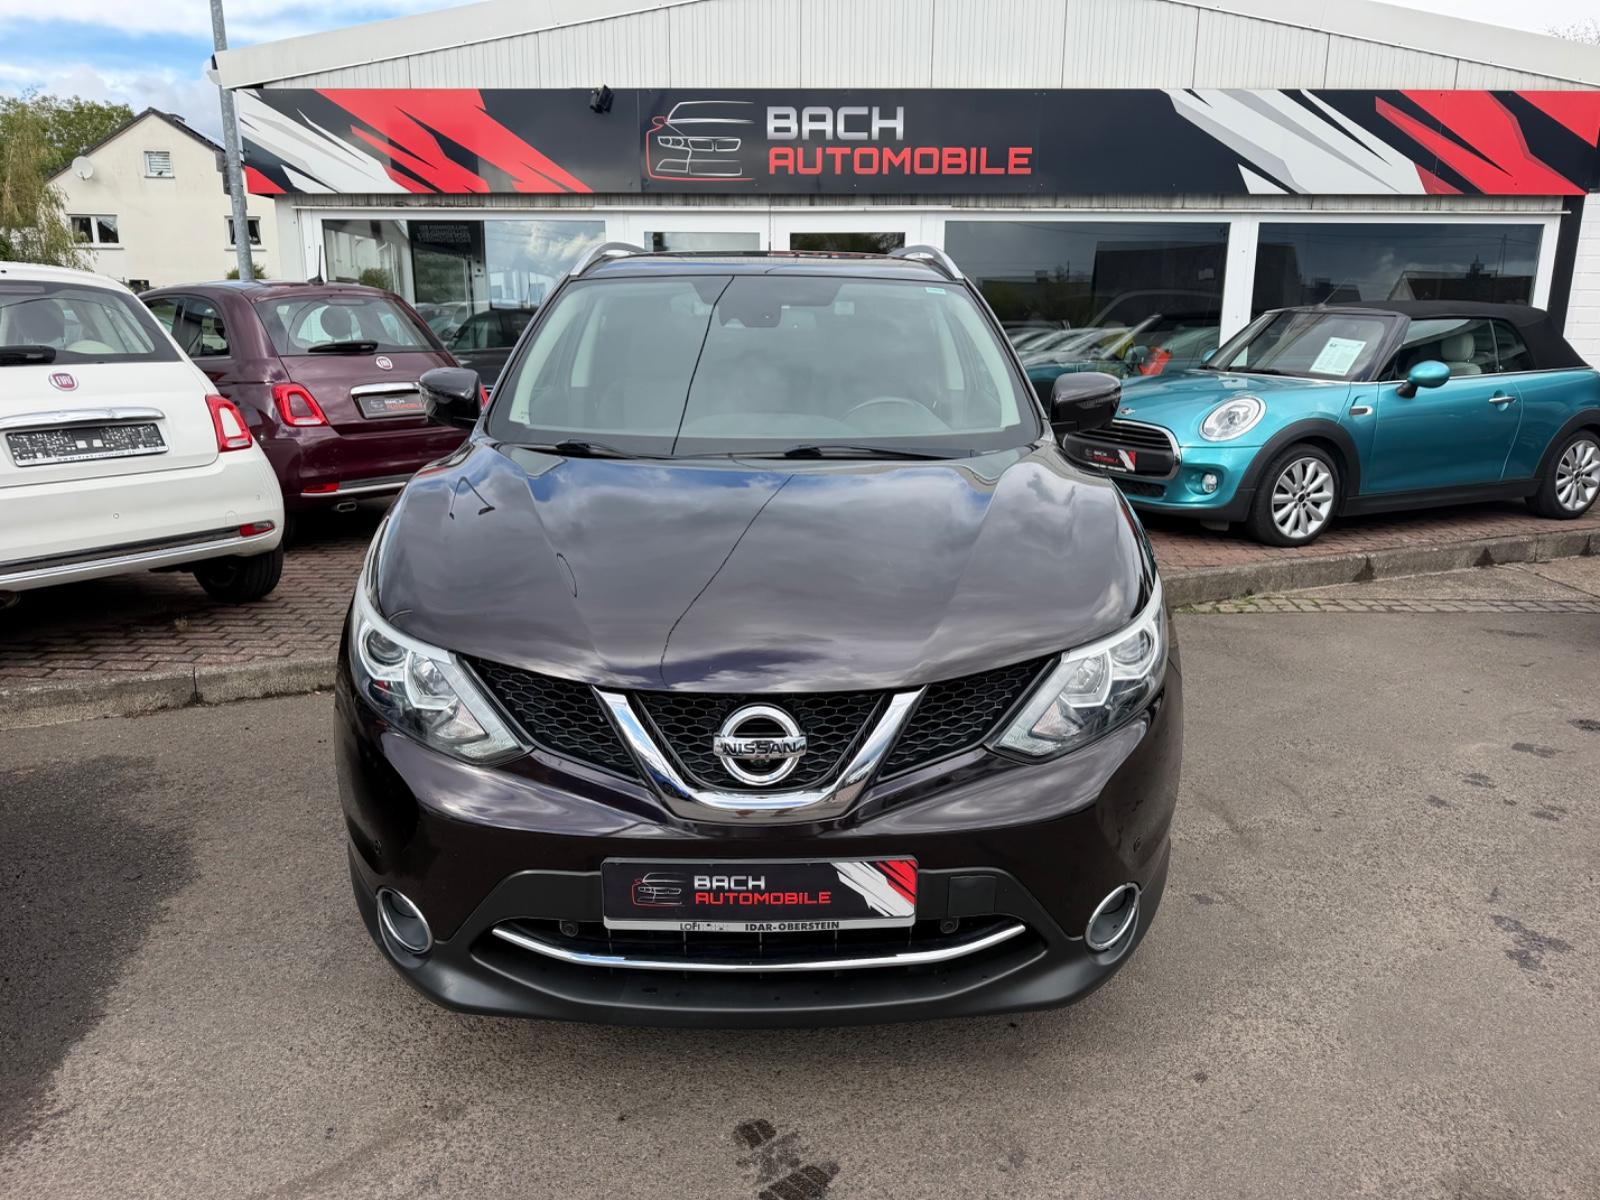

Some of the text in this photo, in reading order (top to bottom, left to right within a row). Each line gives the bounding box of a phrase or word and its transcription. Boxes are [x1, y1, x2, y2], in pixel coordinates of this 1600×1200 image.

[767, 106, 904, 140] BACH
[768, 147, 1032, 175] AUTOMOBILE
[721, 740, 797, 755] NISSAN
[693, 875, 766, 890] BACH
[694, 891, 832, 906] AUTOMOBILE
[744, 921, 840, 931] IDAR-OBERSTEIN
